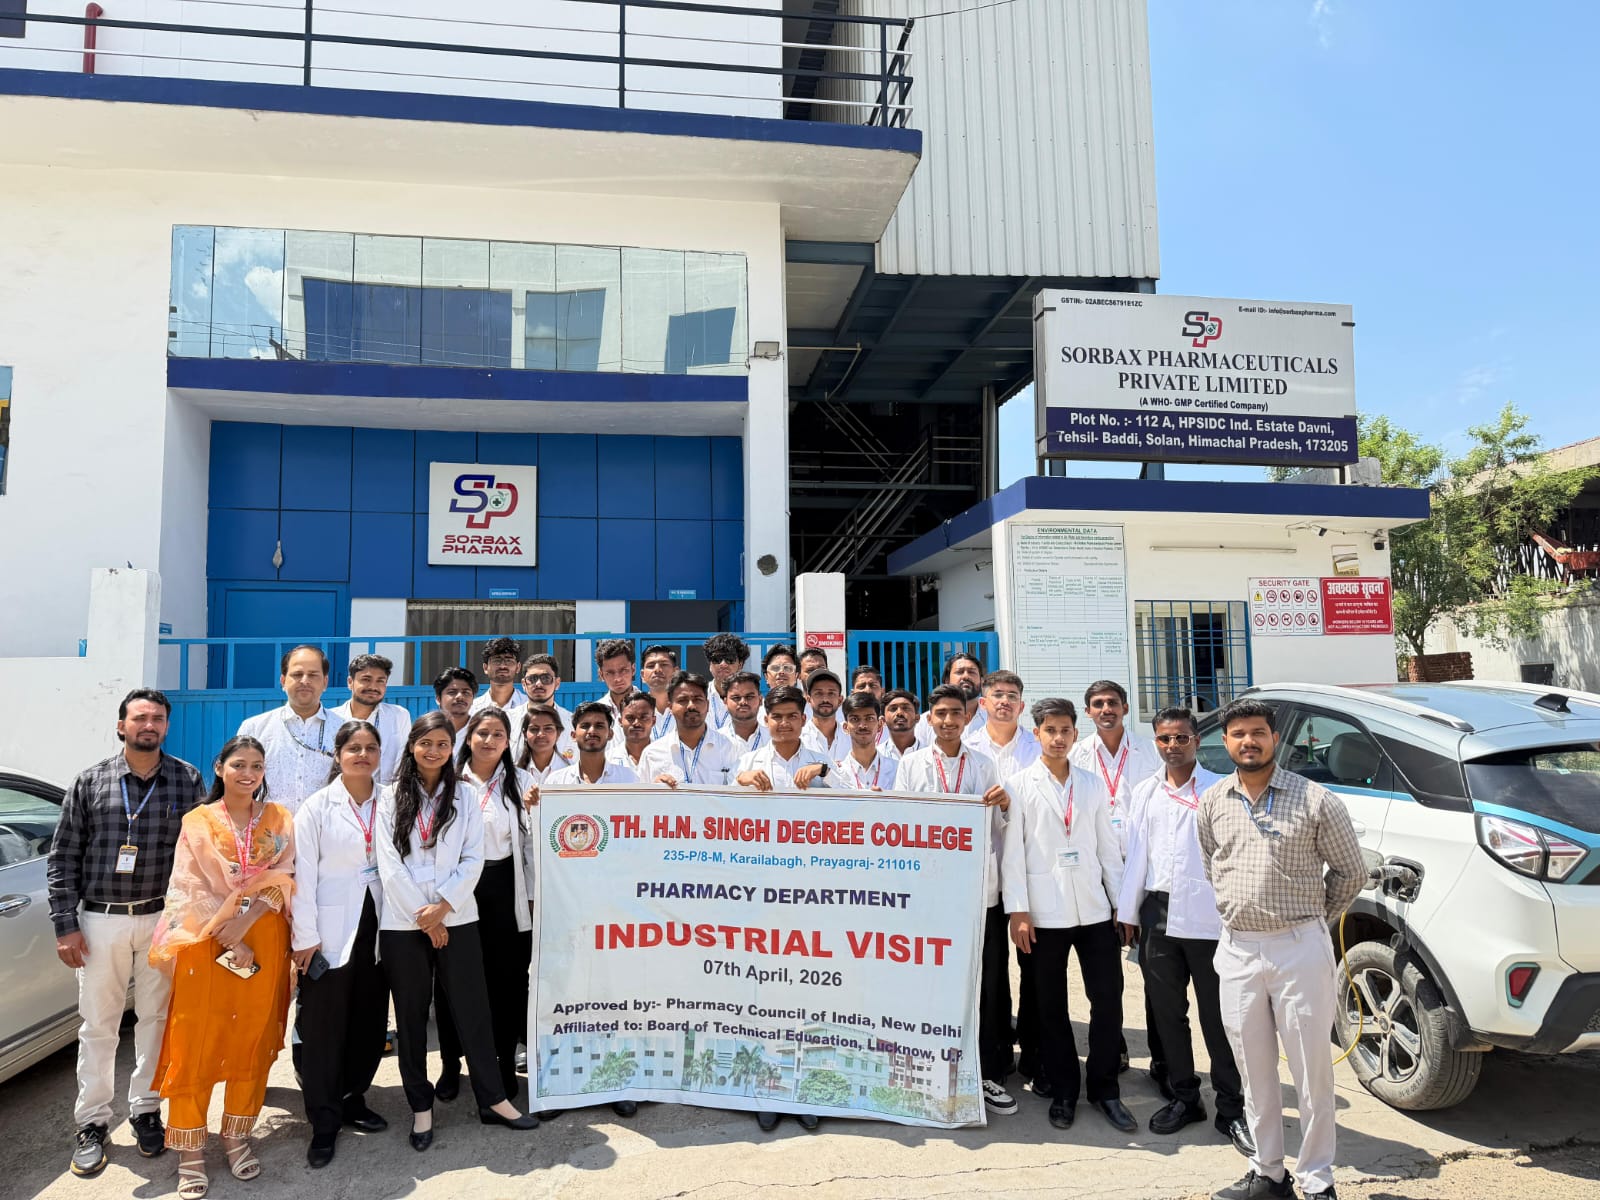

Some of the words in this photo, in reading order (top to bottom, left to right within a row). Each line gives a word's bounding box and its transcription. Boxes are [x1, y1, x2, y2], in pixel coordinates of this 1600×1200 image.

[1061, 346, 1142, 365] SORBAX
[1148, 349, 1338, 375] PHARMACEUTICALS
[1118, 372, 1200, 391] PRIVATE
[1205, 375, 1288, 395] LIMITED
[1140, 397, 1148, 407] (A
[1150, 397, 1172, 407] WHO-
[1174, 398, 1192, 407] GMP
[1195, 399, 1228, 409] Certified
[1230, 400, 1268, 412] Company)
[1070, 412, 1096, 425] Plot
[1099, 413, 1120, 427] No.
[1136, 415, 1159, 427] 112
[1162, 415, 1175, 430] A,
[1179, 416, 1226, 430] HPSIDC
[1230, 418, 1252, 431] Ind.
[1256, 420, 1294, 433] Estate
[1298, 421, 1334, 436] Davni,
[1057, 430, 1098, 443] Tehsil-
[1102, 431, 1142, 447] Baddi,
[1145, 433, 1184, 448] Solan,
[1188, 434, 1245, 449] Himachal
[1250, 436, 1302, 452] Pradesh,
[1306, 439, 1349, 452] 173205
[441, 544, 523, 555] PHARMA
[444, 534, 521, 545] SORBAX
[610, 815, 646, 838] TH.
[653, 815, 697, 839] H.N.
[703, 816, 770, 843] SINGH
[777, 819, 864, 845] DEGREE
[870, 822, 973, 851] COLLEGE
[663, 850, 726, 864] 235-P/8-M,
[730, 852, 806, 869] Karailabagh,
[810, 855, 875, 870] Prayagraj-
[878, 858, 921, 871] 211016
[636, 882, 757, 902] PHARMACY
[763, 888, 911, 909] DEPARTMENT
[595, 921, 833, 958] INDUSTRIAL
[846, 930, 952, 966] VISIT
[703, 959, 741, 977] 07th
[745, 965, 793, 985] April,
[799, 968, 843, 987] 2026
[553, 999, 628, 1015] Approved
[633, 999, 661, 1012] by:-
[666, 998, 743, 1016] Pharmacy
[748, 1004, 806, 1020] Council
[811, 1011, 827, 1022] of
[832, 1011, 876, 1029] India,
[881, 1015, 916, 1033] New
[920, 1022, 962, 1038] Delhi
[553, 1020, 619, 1035] Affiliated
[624, 1020, 643, 1031] to:
[647, 1020, 690, 1032] Board
[694, 1020, 708, 1032] of
[713, 1021, 781, 1040] Technical
[785, 1029, 863, 1051] Education,
[867, 1038, 936, 1062] Lucknow,
